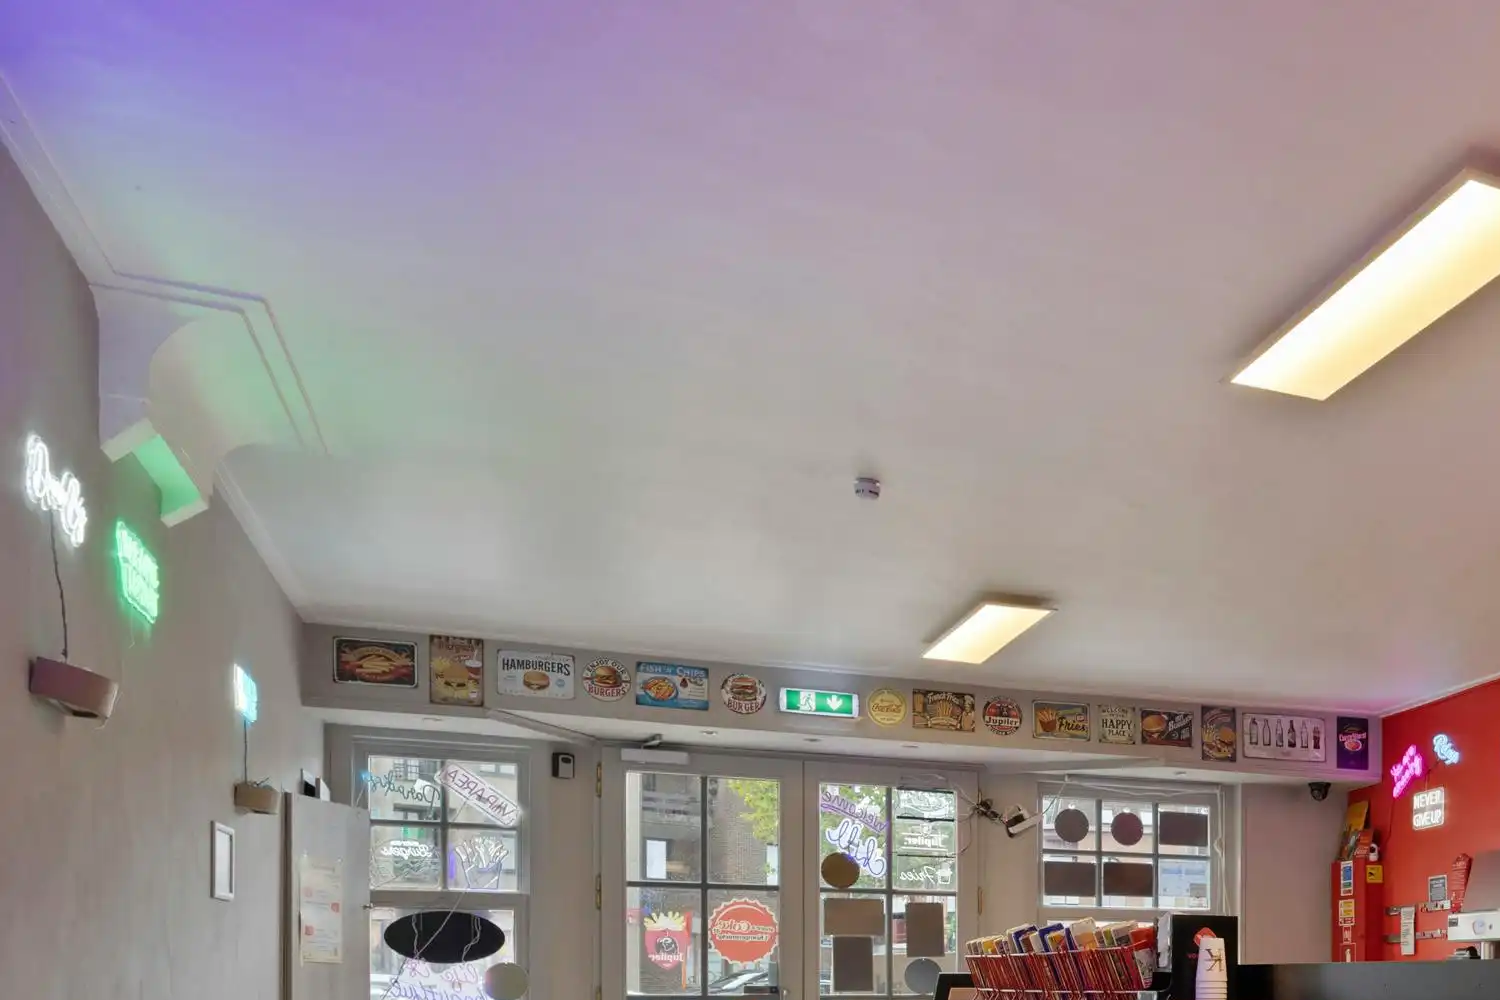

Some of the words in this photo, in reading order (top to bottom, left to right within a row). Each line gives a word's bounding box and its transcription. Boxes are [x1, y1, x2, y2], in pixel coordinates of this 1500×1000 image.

[502, 657, 571, 676] HAMBURGERS
[586, 656, 609, 673] ENJOY
[611, 661, 627, 676] OUR
[640, 662, 662, 673] FISH
[676, 666, 706, 678] CHIPS
[588, 685, 627, 698] BURGERS
[727, 698, 760, 712] BURGER
[985, 716, 1019, 726] Jupiler
[1101, 718, 1133, 730] HAPPY
[1107, 728, 1127, 737] PLACE
[1414, 790, 1441, 809] NEVER
